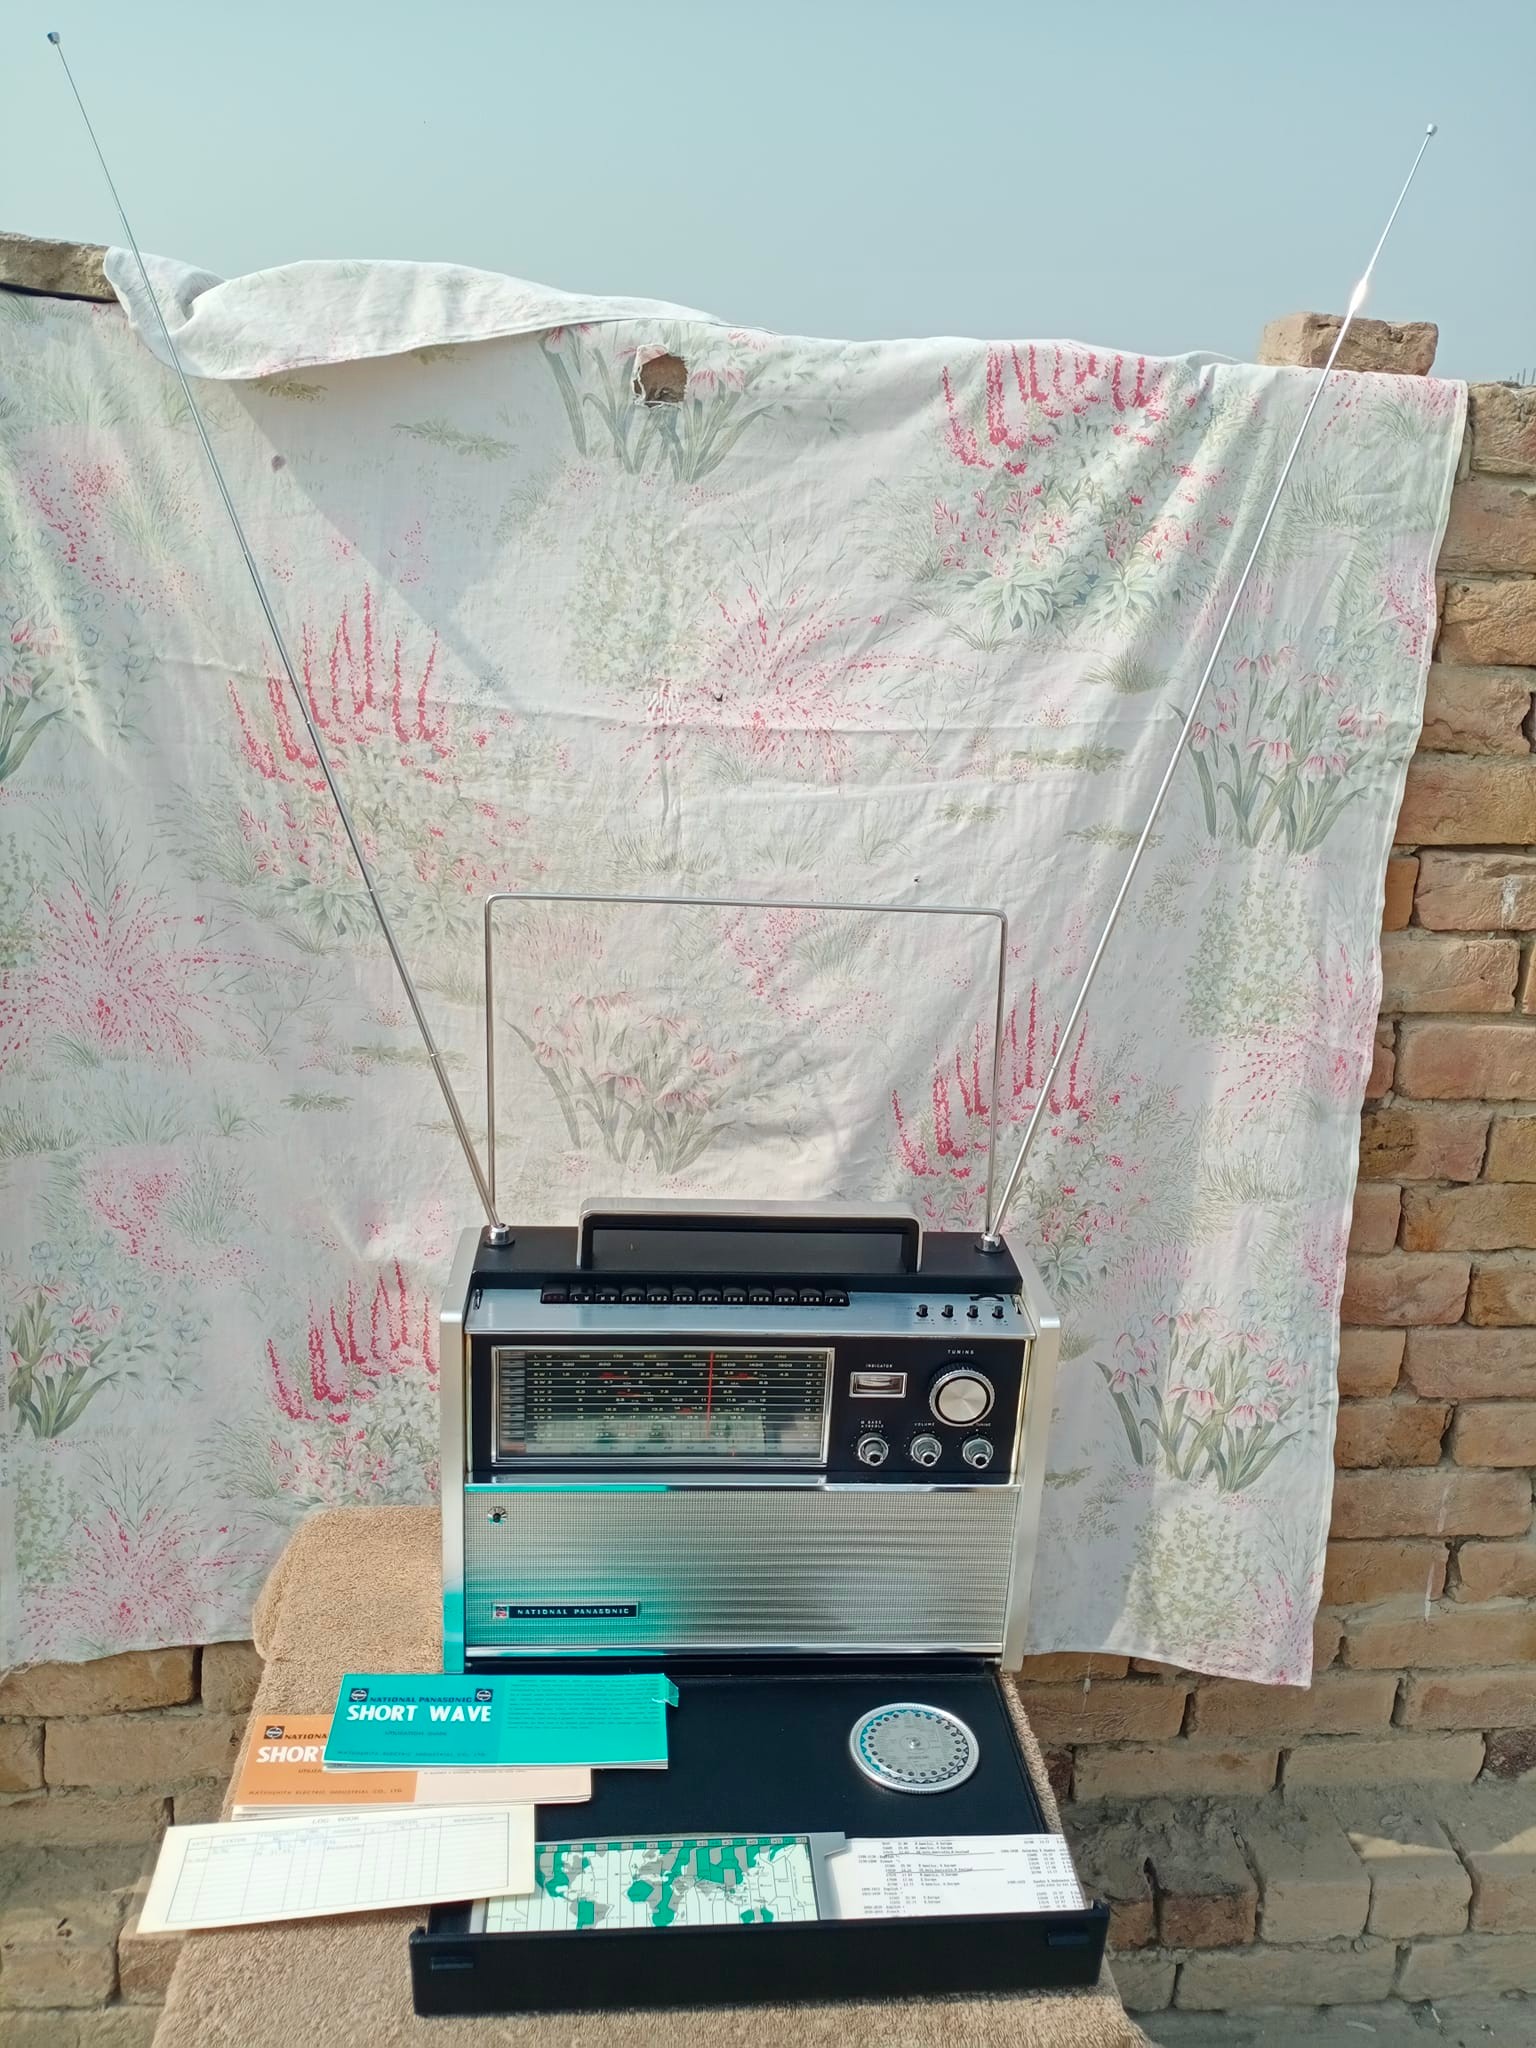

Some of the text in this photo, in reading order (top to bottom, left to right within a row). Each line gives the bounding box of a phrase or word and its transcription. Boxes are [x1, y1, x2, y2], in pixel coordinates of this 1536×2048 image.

[574, 1607, 630, 1615] PANASONIC
[346, 1704, 492, 1722] SHORT WAVE
